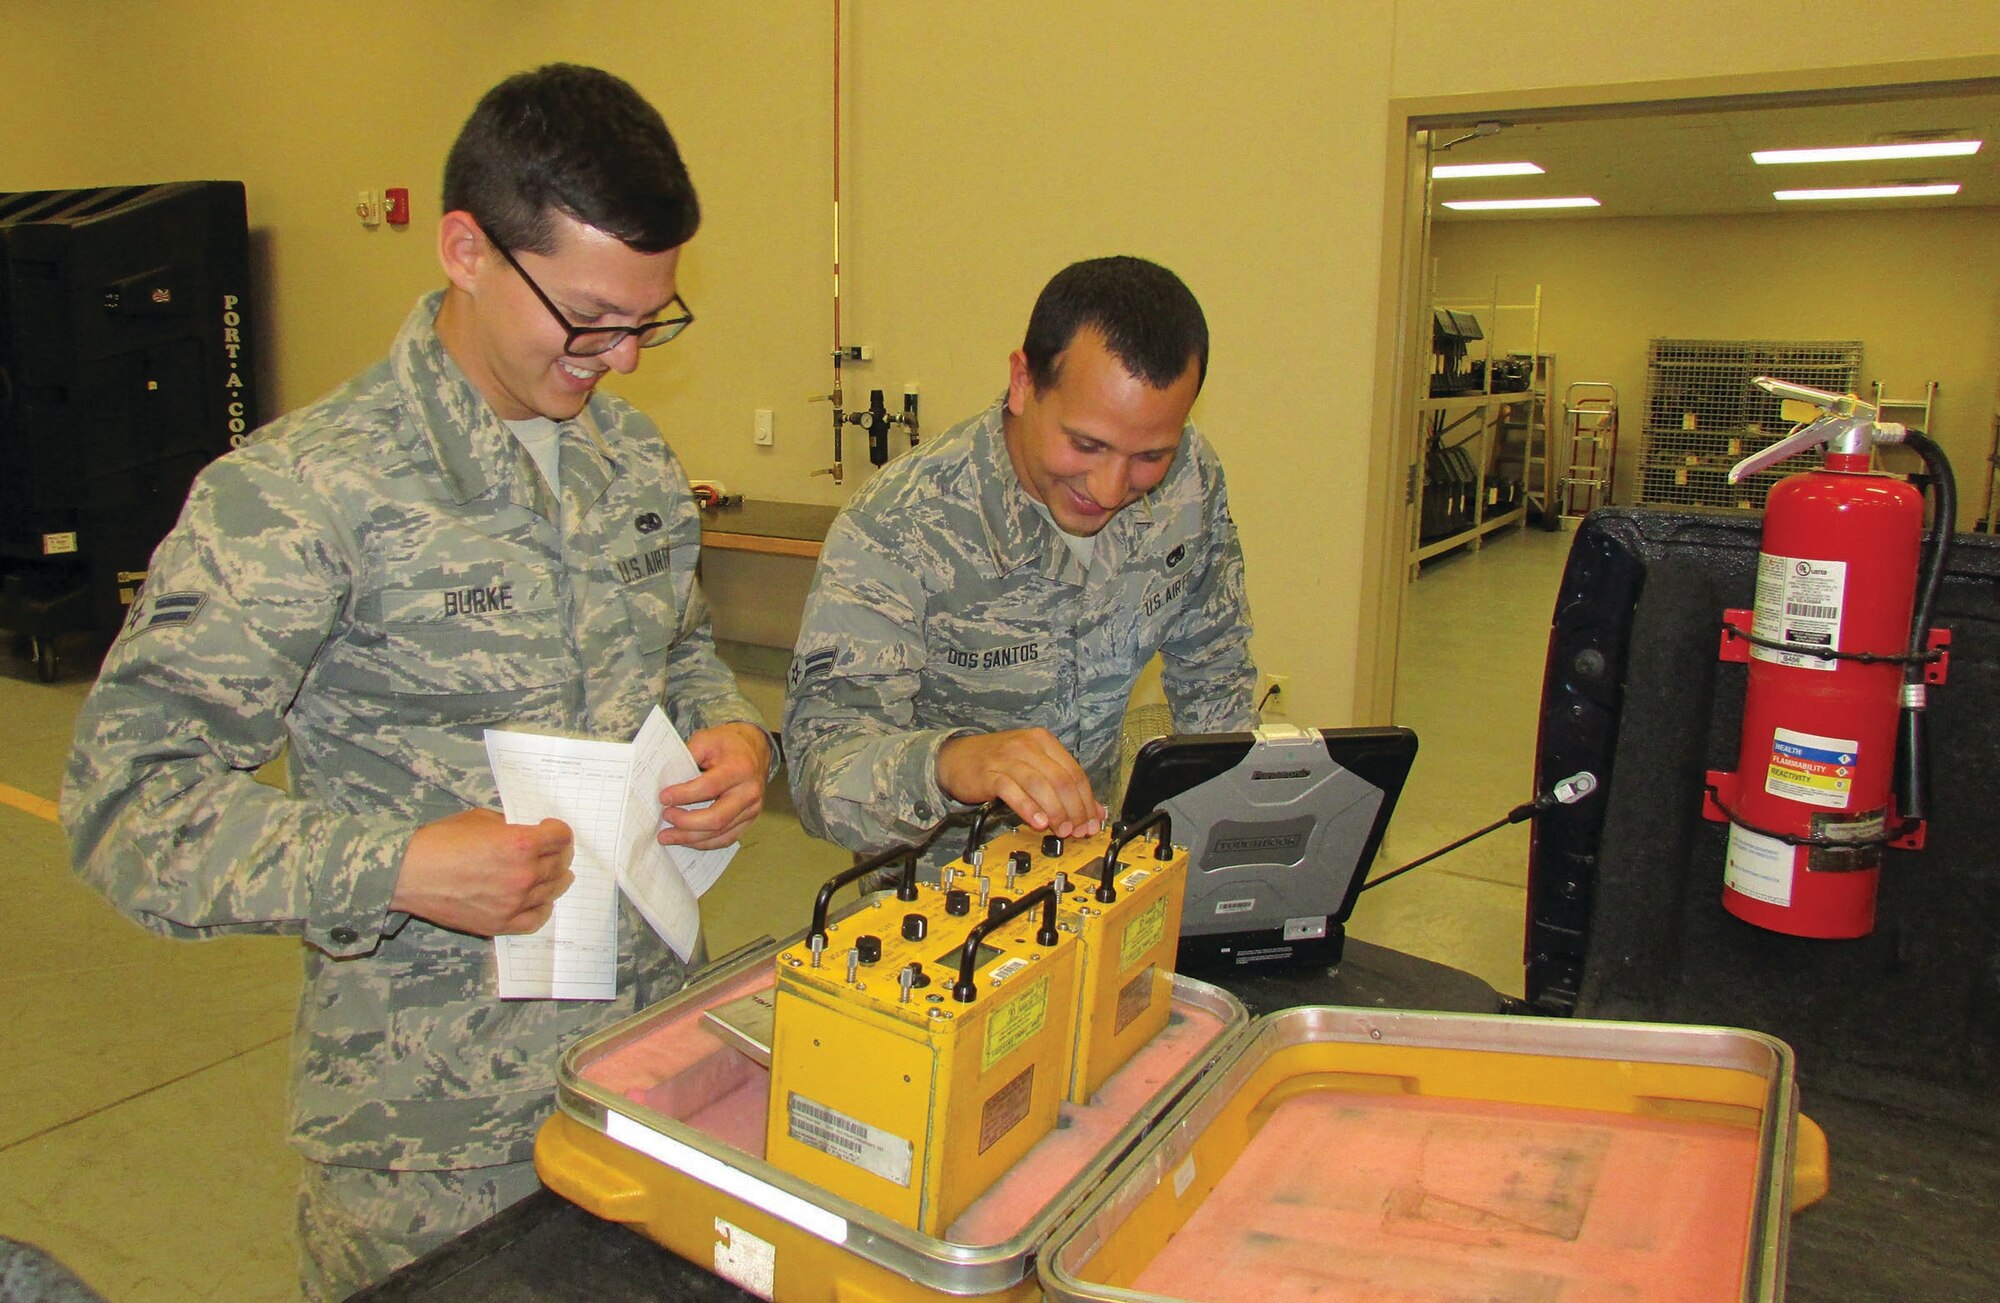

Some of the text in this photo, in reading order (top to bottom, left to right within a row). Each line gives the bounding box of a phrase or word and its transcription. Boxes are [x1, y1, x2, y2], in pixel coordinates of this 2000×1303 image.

[444, 585, 514, 616] BURKE
[947, 643, 1038, 669] DOS SANTOS
[1775, 743, 1801, 755] HEALTH
[1772, 755, 1826, 773] FLAMMABILITY
[1771, 768, 1811, 782] REACTIVITY
